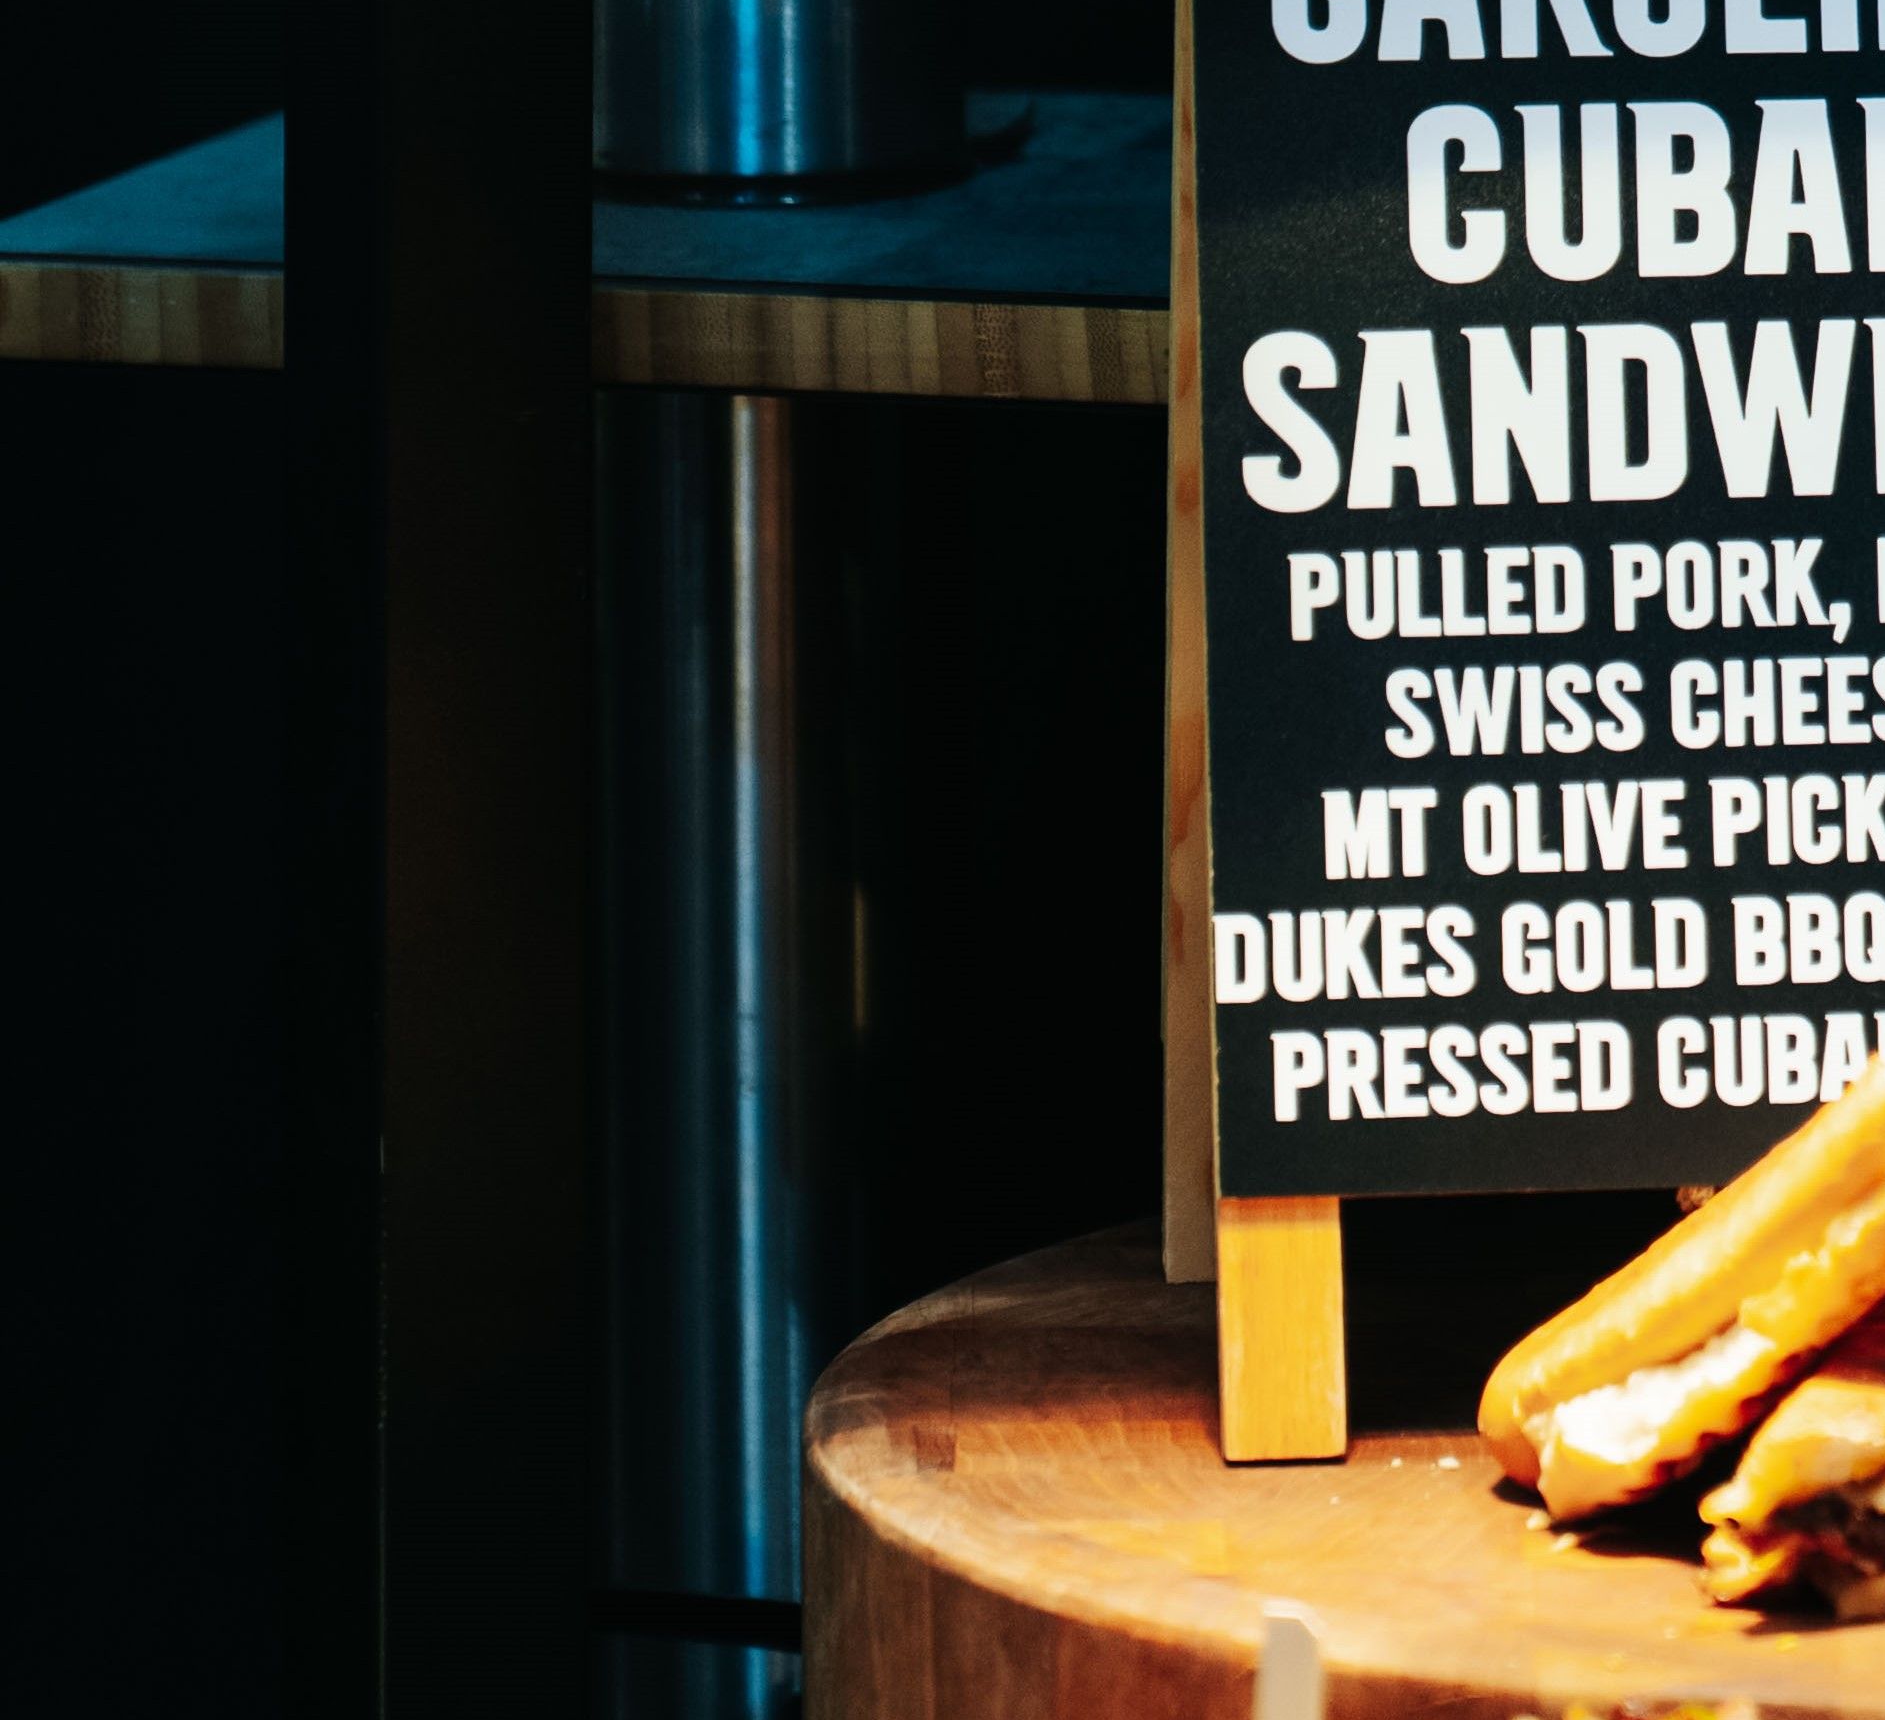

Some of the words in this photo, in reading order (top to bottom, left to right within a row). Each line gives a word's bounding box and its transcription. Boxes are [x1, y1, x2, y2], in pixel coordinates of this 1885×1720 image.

[1288, 546, 1585, 641] PULLED
[1610, 539, 1851, 643] PORK,
[1385, 662, 1644, 758] SWISS
[1321, 787, 1437, 879] MT
[1463, 779, 1687, 875] OLIVE
[1213, 908, 1476, 1004] DUKES
[1502, 898, 1707, 994] GOLD
[1270, 1020, 1632, 1121] PRESSED
